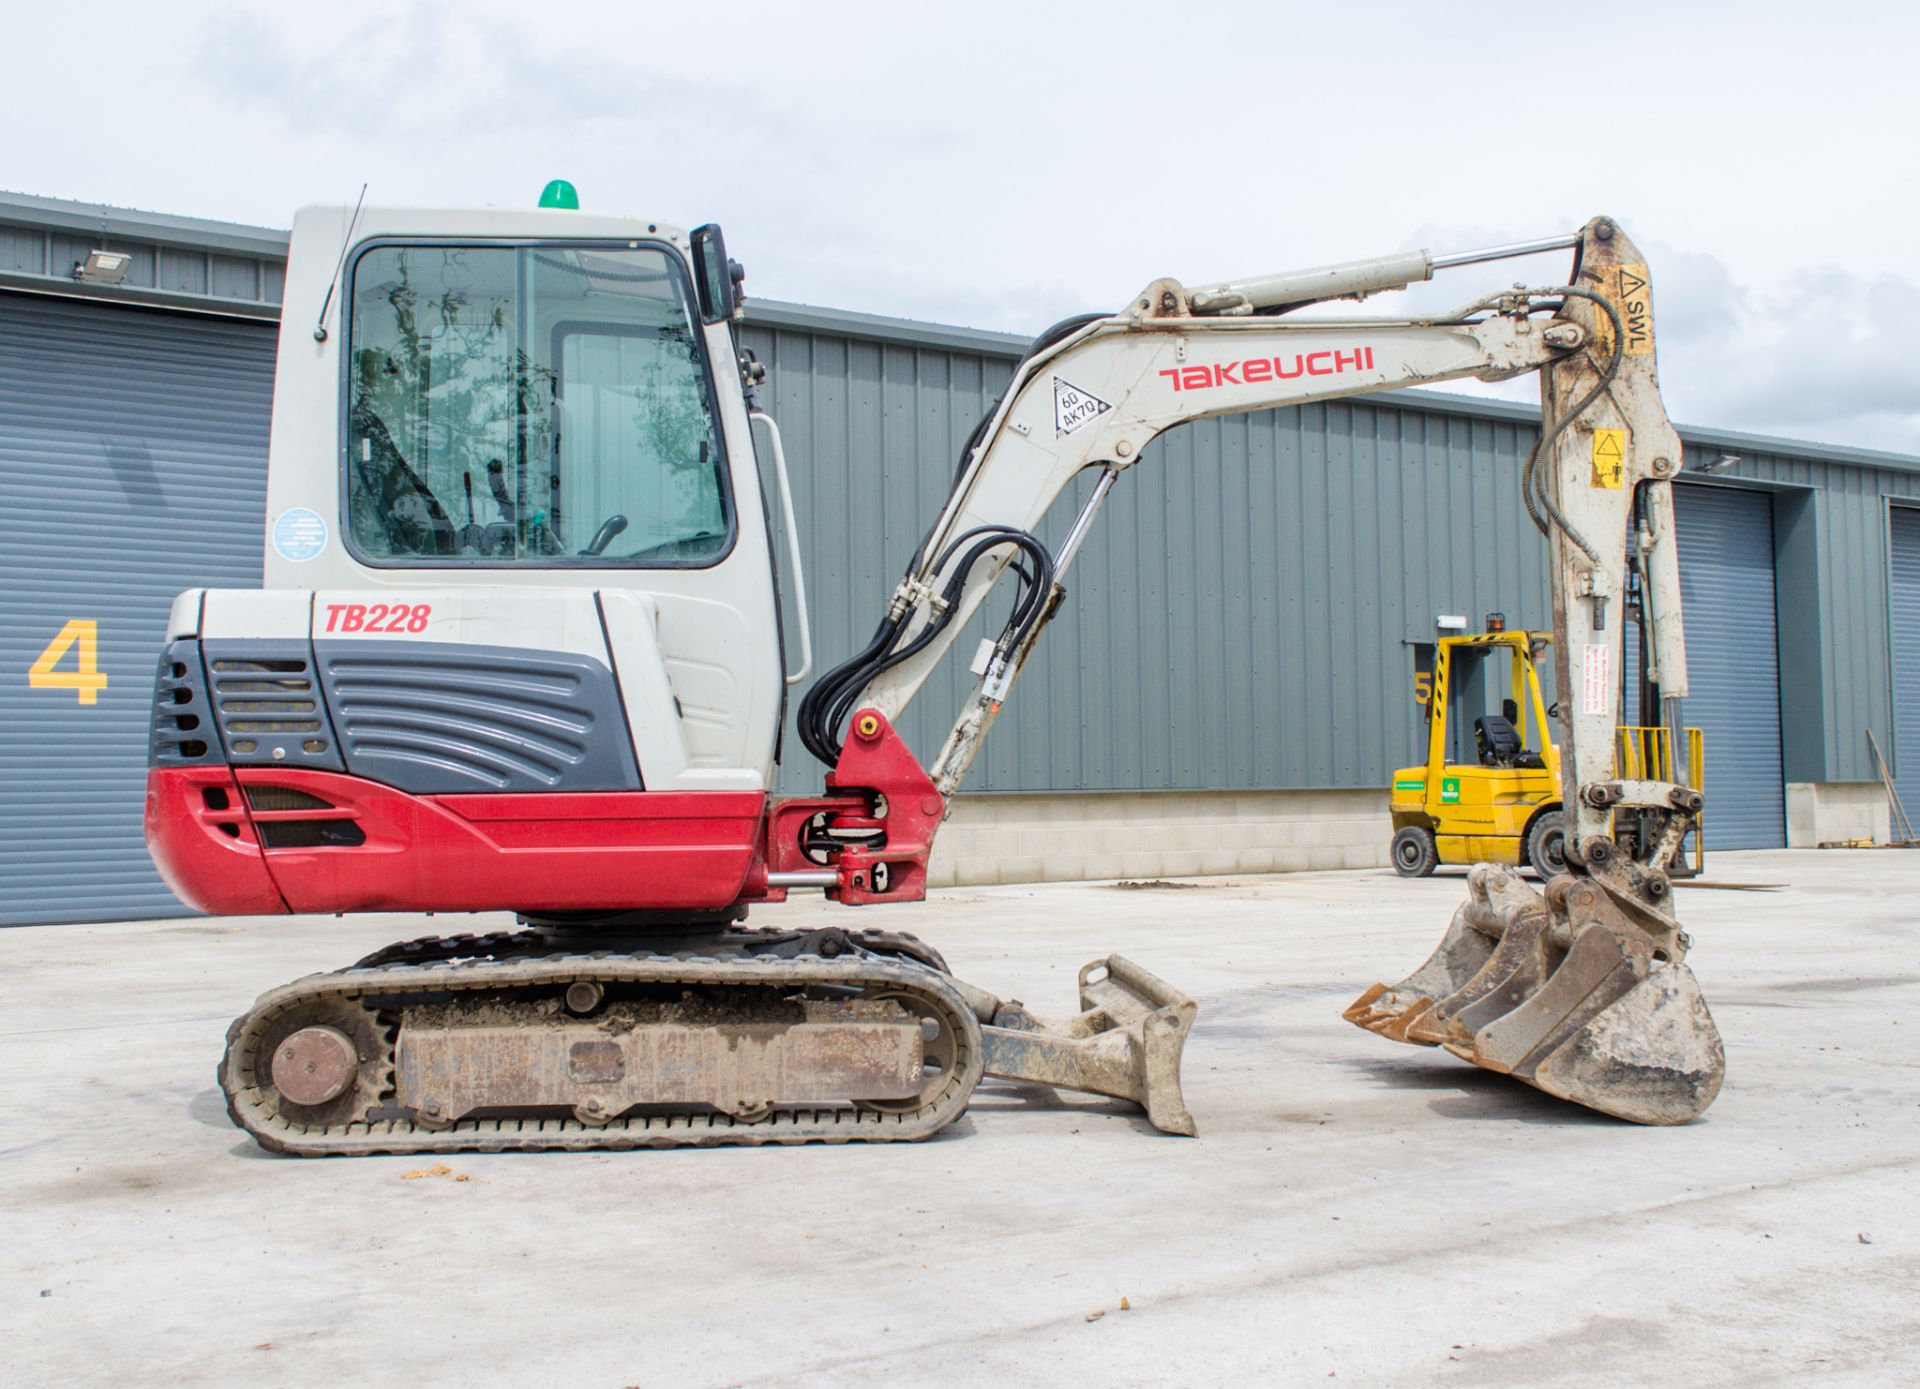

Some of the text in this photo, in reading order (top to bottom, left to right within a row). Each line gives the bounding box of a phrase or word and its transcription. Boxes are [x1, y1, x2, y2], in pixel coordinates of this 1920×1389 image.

[1627, 301, 1646, 349] SWL
[326, 604, 432, 633] TB228
[29, 619, 107, 705] 4
[1416, 672, 1431, 704] 5
